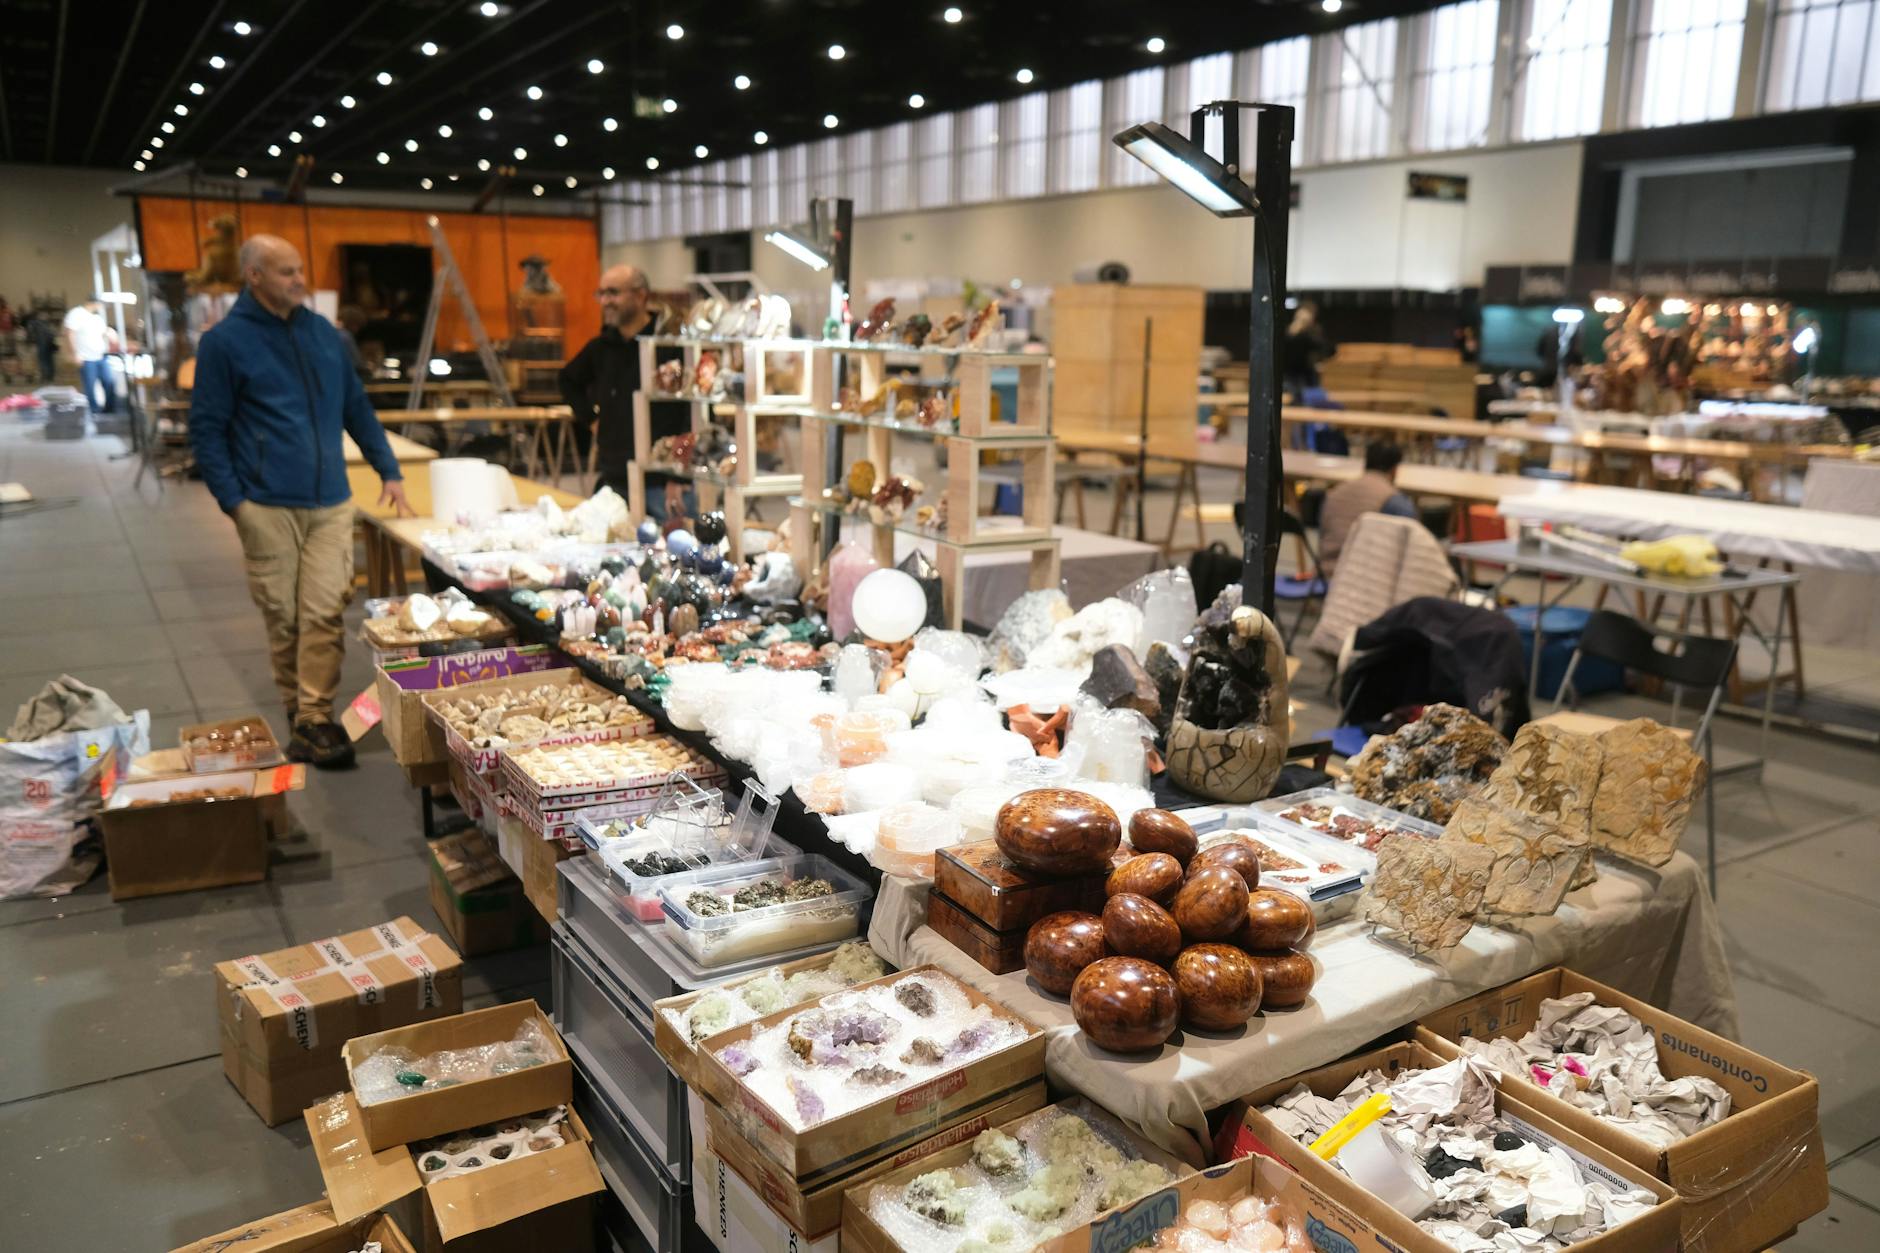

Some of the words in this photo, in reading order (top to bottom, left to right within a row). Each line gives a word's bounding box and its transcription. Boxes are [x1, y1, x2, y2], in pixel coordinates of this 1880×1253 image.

[27, 782, 48, 799] 20
[1661, 1032, 1768, 1093] Contenants
[899, 1074, 963, 1105] Hollandaise
[897, 1118, 984, 1162] Hollandaise
